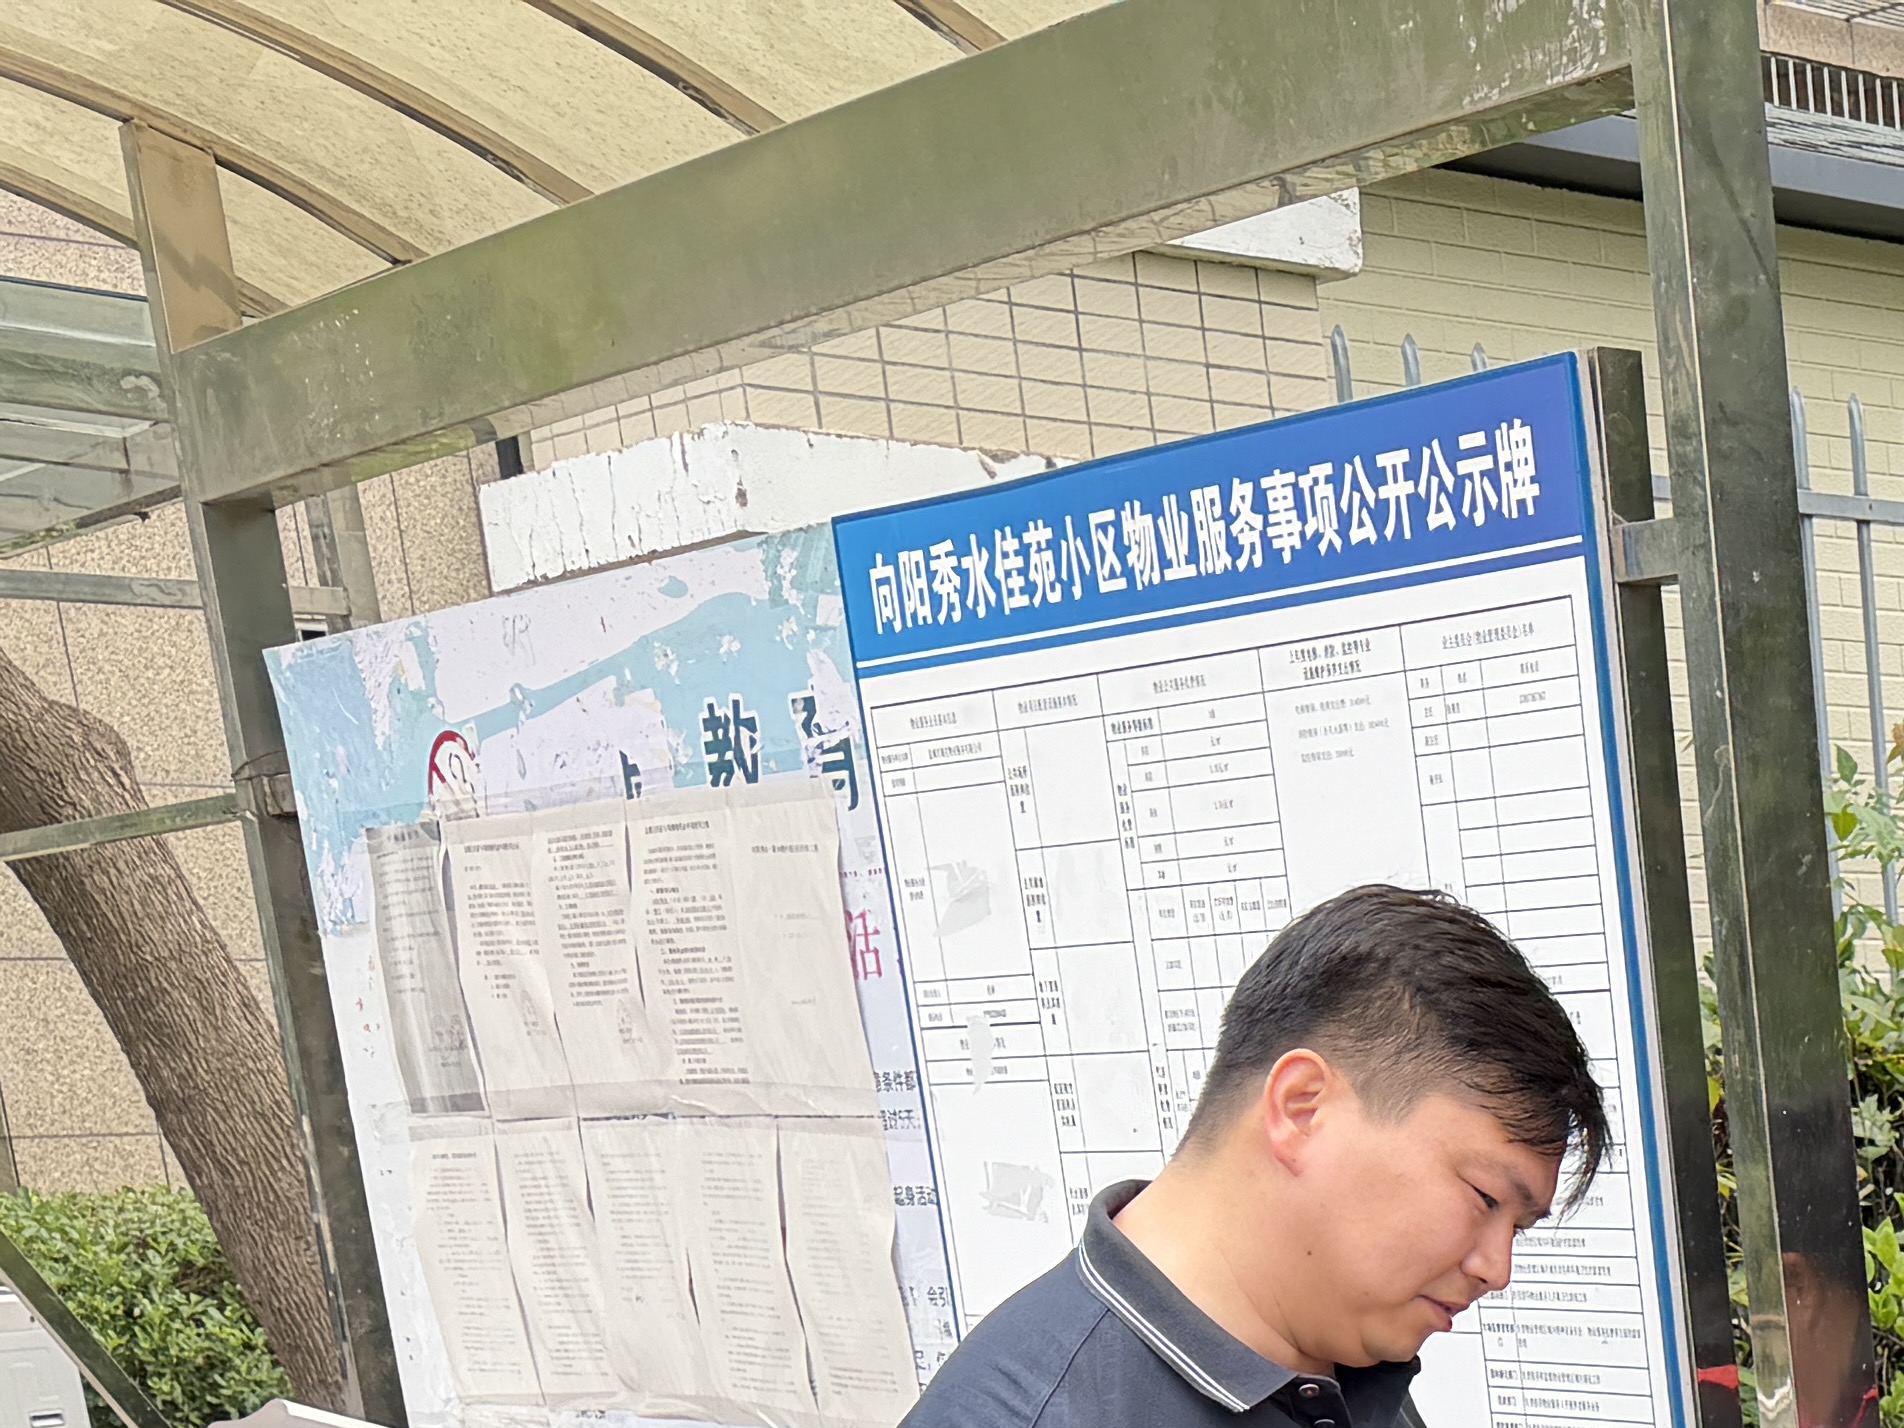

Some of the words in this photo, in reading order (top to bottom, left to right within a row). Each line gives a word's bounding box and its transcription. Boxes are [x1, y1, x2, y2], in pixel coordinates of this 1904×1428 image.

[869, 418, 1541, 636] 向阳秀水佳苑小区物业服务事项公开公示牌
